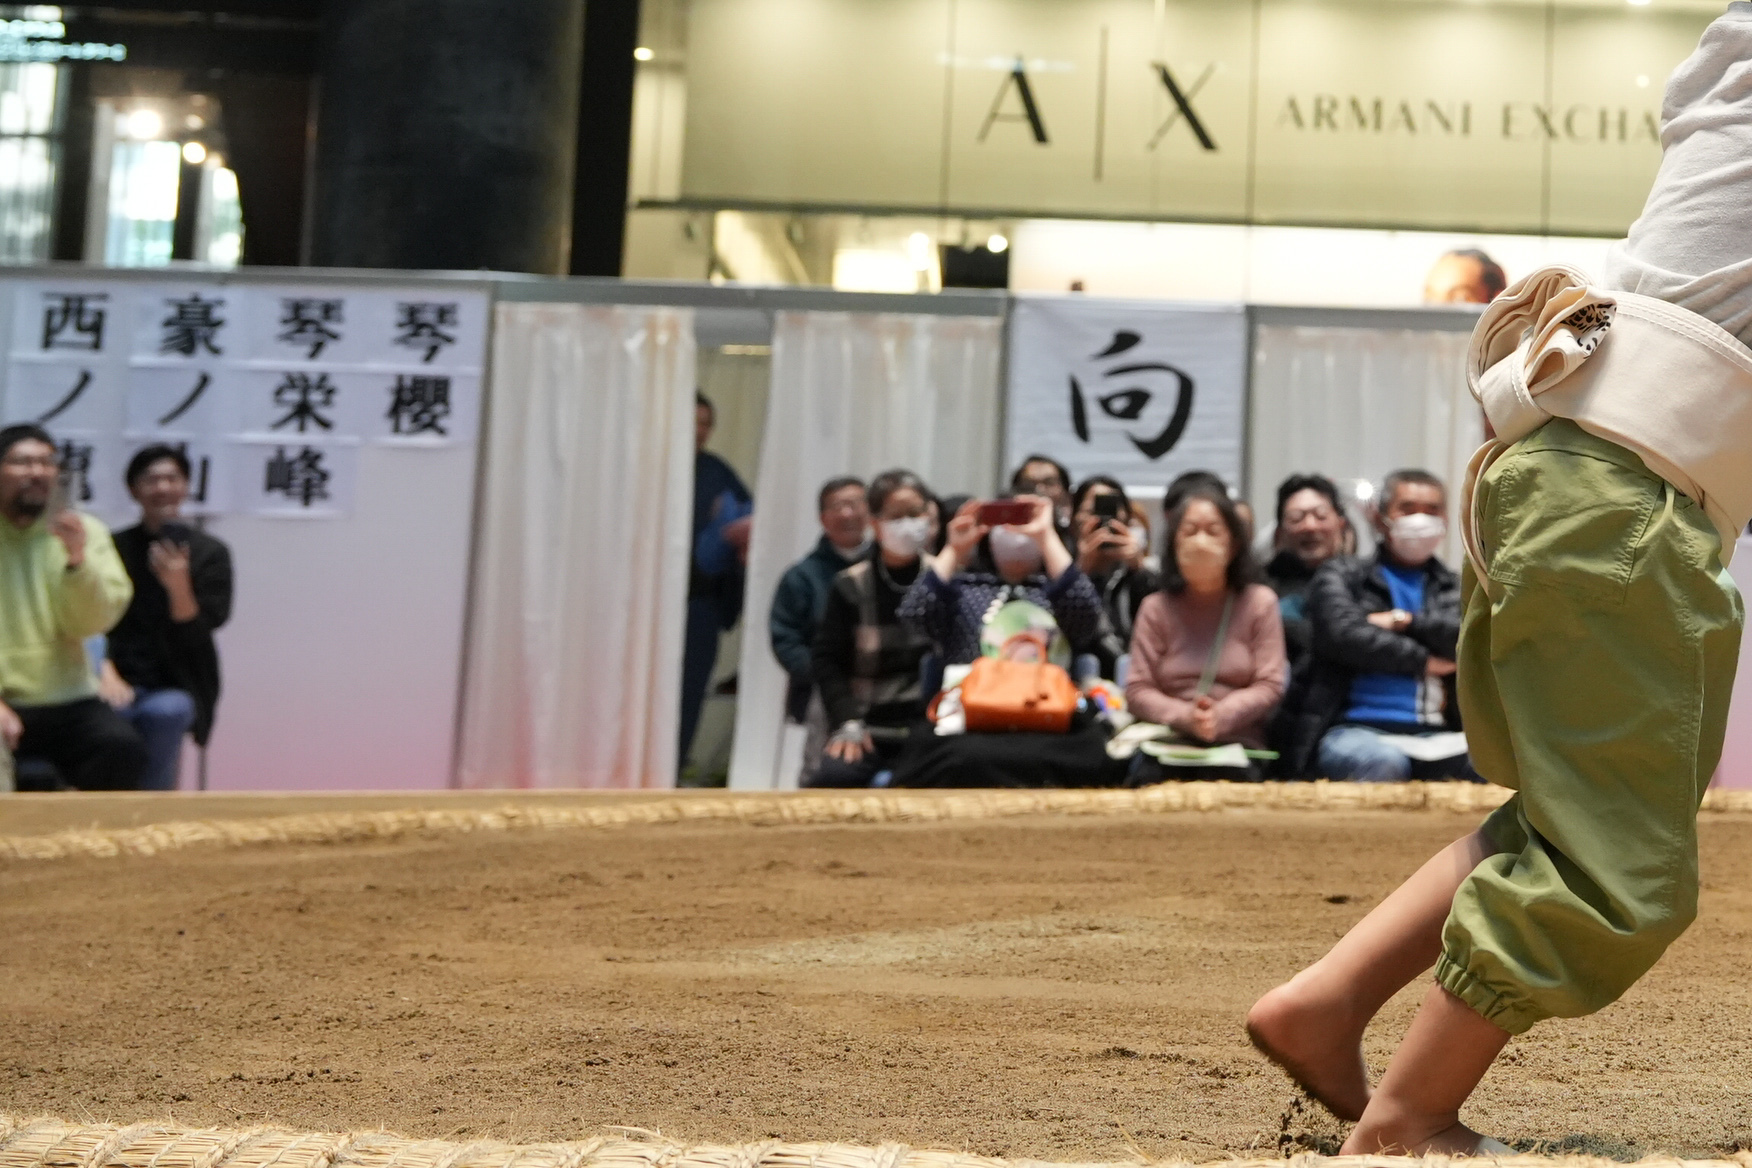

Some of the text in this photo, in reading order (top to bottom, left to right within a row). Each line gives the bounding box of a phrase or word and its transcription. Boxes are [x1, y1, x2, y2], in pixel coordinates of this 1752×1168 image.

[1276, 93, 1661, 144] ARMANI EXCHA
[264, 297, 344, 507] 琴栄峰
[387, 302, 459, 435] 琴櫻
[1069, 330, 1195, 461] 向
